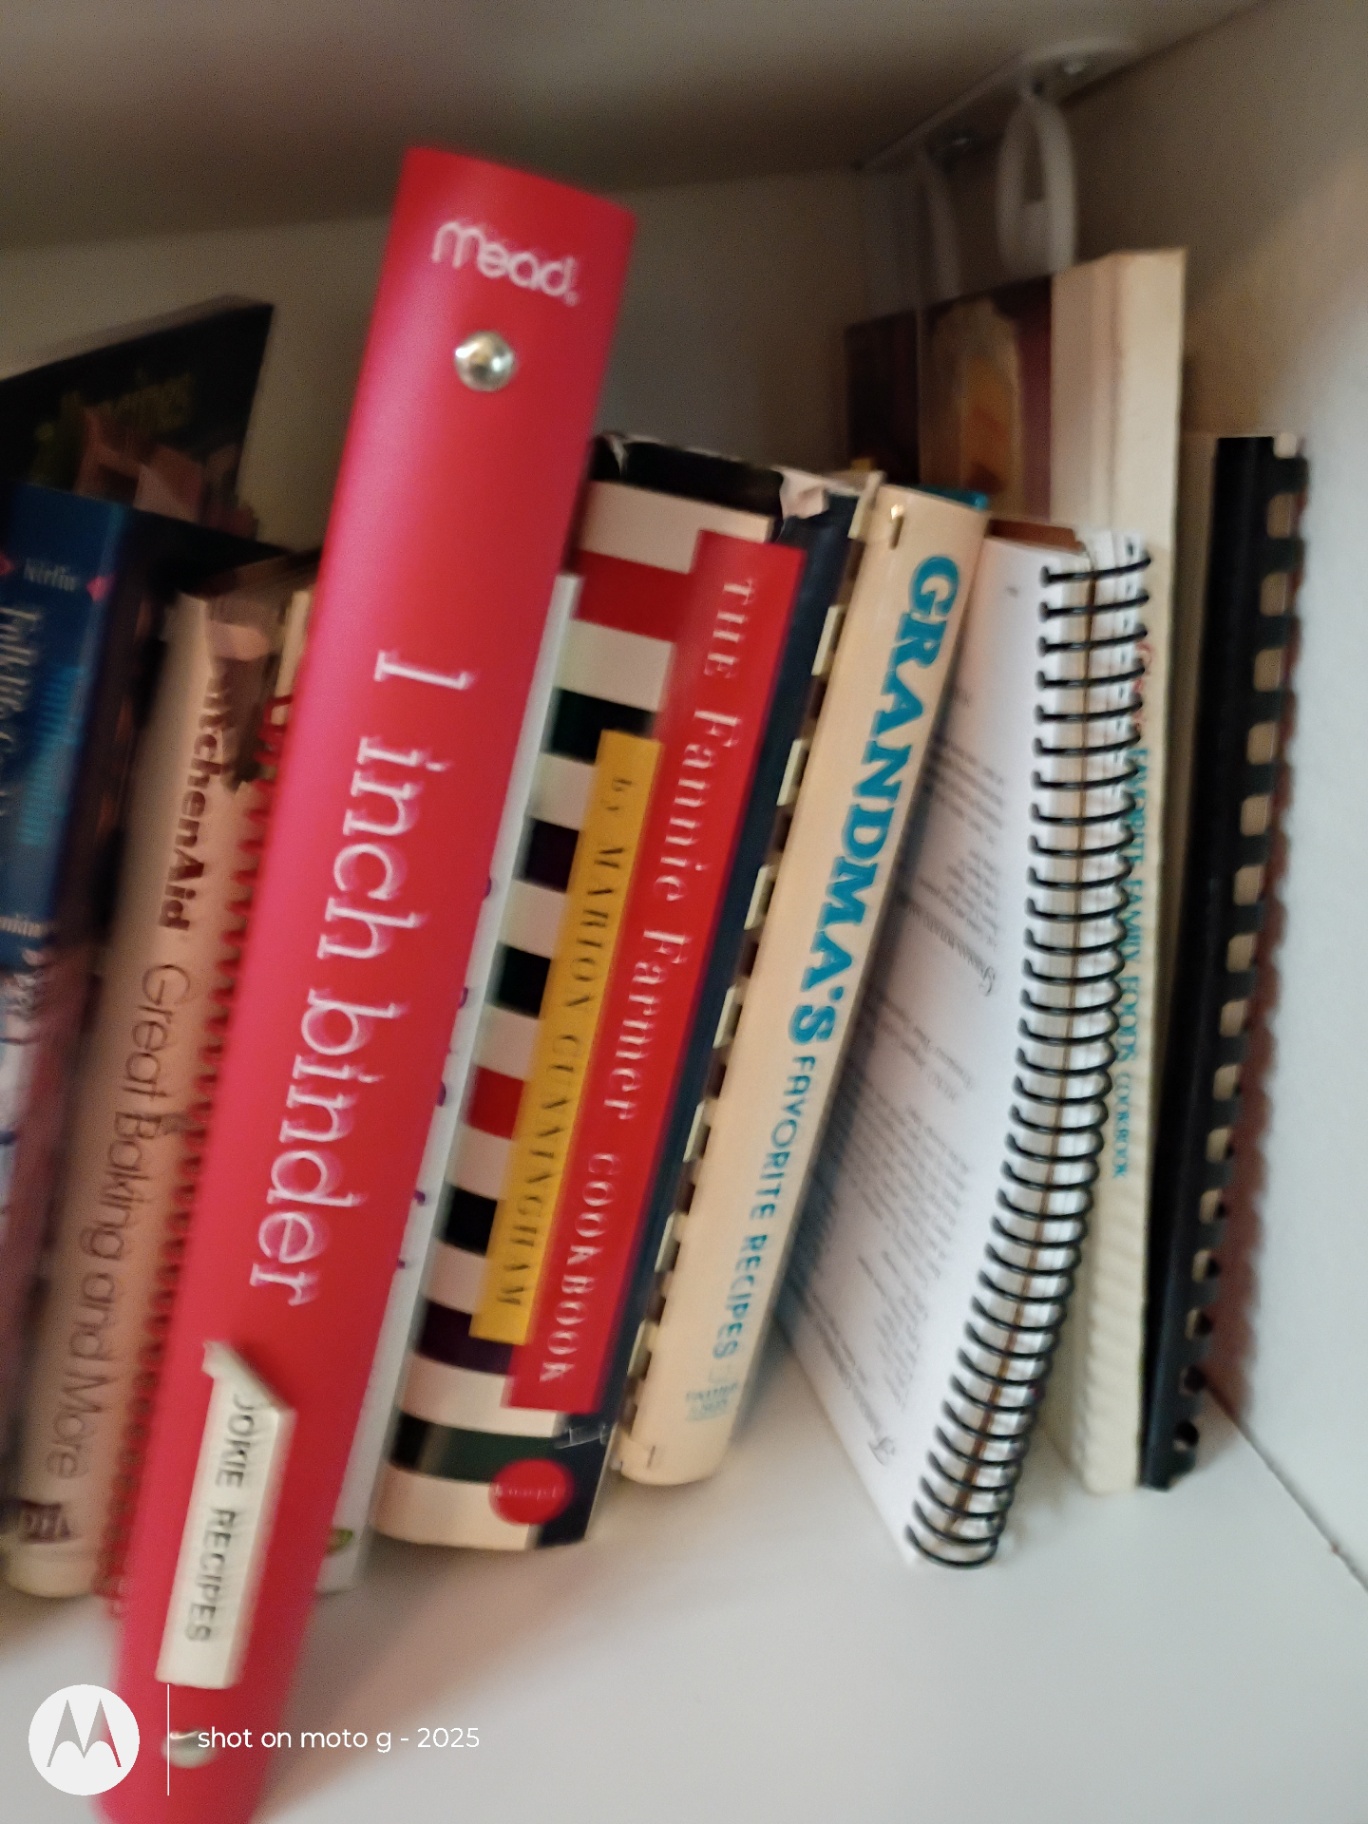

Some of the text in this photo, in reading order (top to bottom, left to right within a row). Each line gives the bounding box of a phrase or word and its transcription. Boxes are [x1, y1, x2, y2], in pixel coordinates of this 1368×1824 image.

[316, 735, 448, 960] inch
[788, 554, 961, 1046] GRANDMA'S
[122, 963, 191, 1101] Great
[538, 576, 757, 1384] THE Fannie Farmer COOKBOOK
[79, 1109, 162, 1260] Baking
[250, 987, 406, 1307] binder
[749, 1055, 818, 1222] FAVORITE
[68, 1271, 118, 1361] and
[713, 1233, 769, 1361] RECIPES
[46, 1370, 113, 1481] More
[184, 1504, 239, 1643] RECIPES
